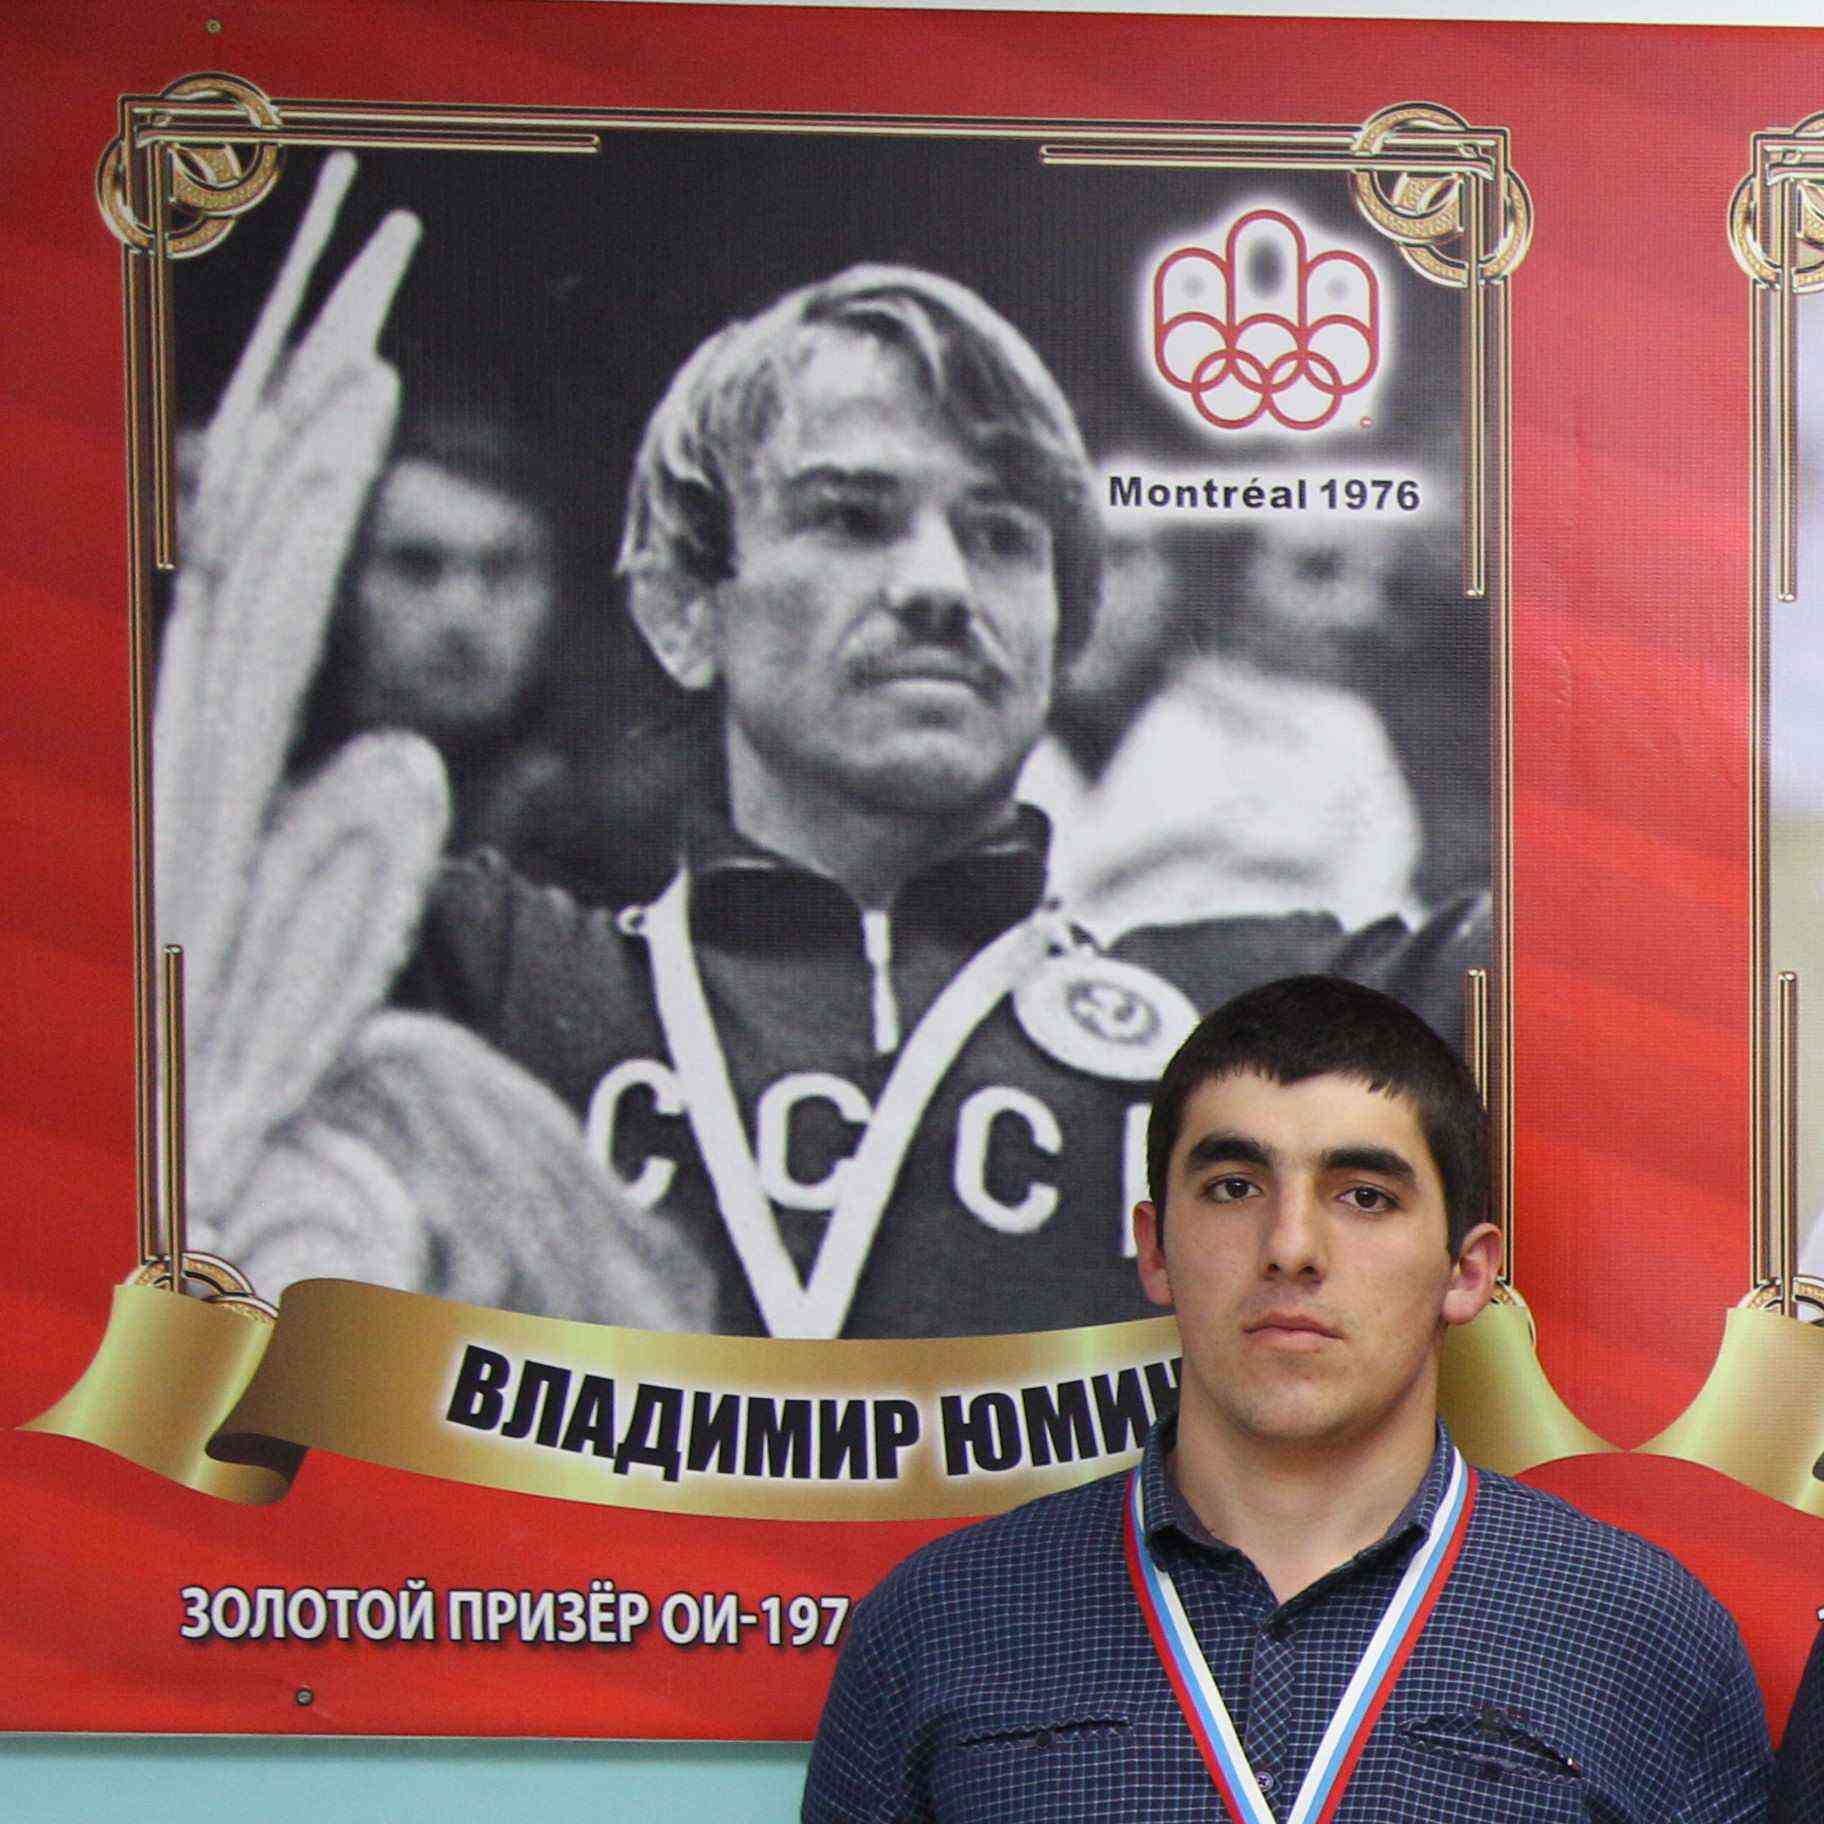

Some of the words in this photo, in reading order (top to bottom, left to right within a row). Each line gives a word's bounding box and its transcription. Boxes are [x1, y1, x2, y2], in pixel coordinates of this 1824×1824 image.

[1108, 475, 1307, 510] Montréal
[1320, 478, 1421, 512] 1976
[585, 1058, 1152, 1258] ССС
[445, 1344, 920, 1482] ВЛАДИМИР
[180, 1579, 435, 1642] ЗОЛОТОЙ
[448, 1581, 651, 1646] ПРИЗЁР
[660, 1594, 850, 1647] ОИ-197
